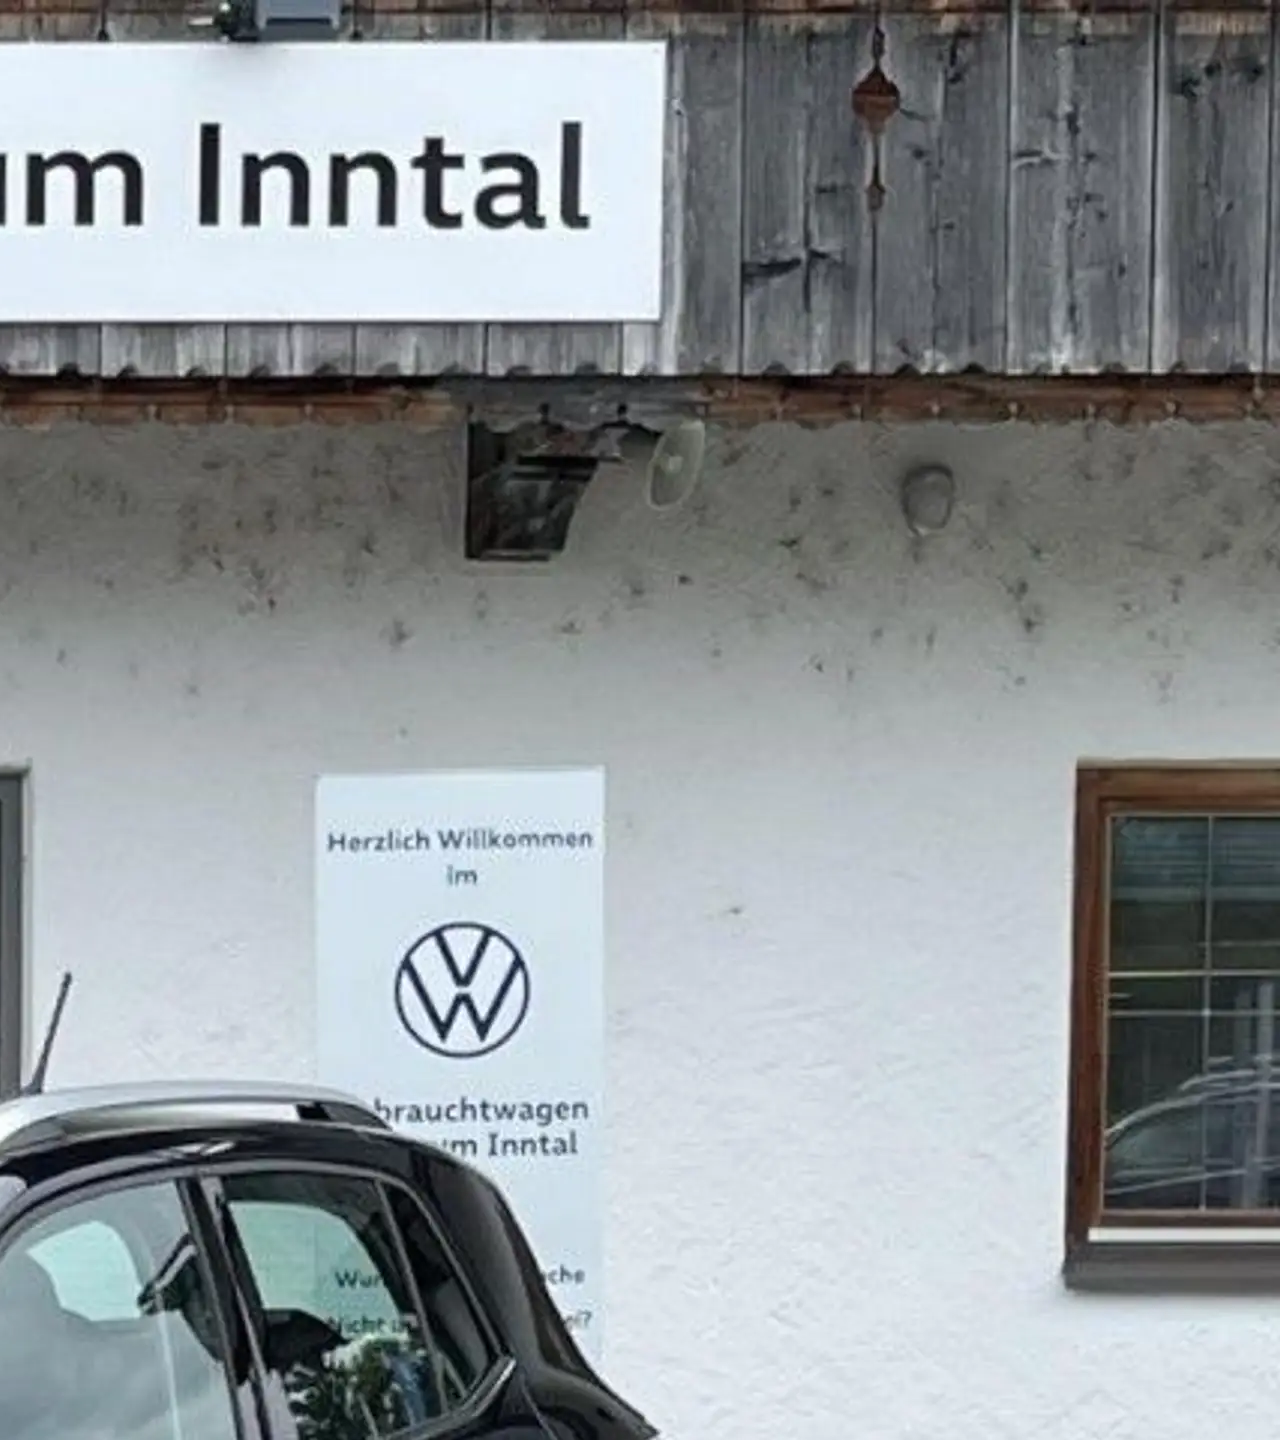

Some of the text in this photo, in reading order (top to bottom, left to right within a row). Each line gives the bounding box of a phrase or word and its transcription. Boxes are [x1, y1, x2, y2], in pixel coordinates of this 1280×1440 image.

[197, 120, 590, 230] Inntal
[326, 829, 594, 852] Herzlich Willkommen
[446, 865, 478, 885] im
[394, 921, 531, 1058] VW
[374, 1097, 589, 1126] brauchtwagen
[487, 1131, 578, 1156] Inntal
